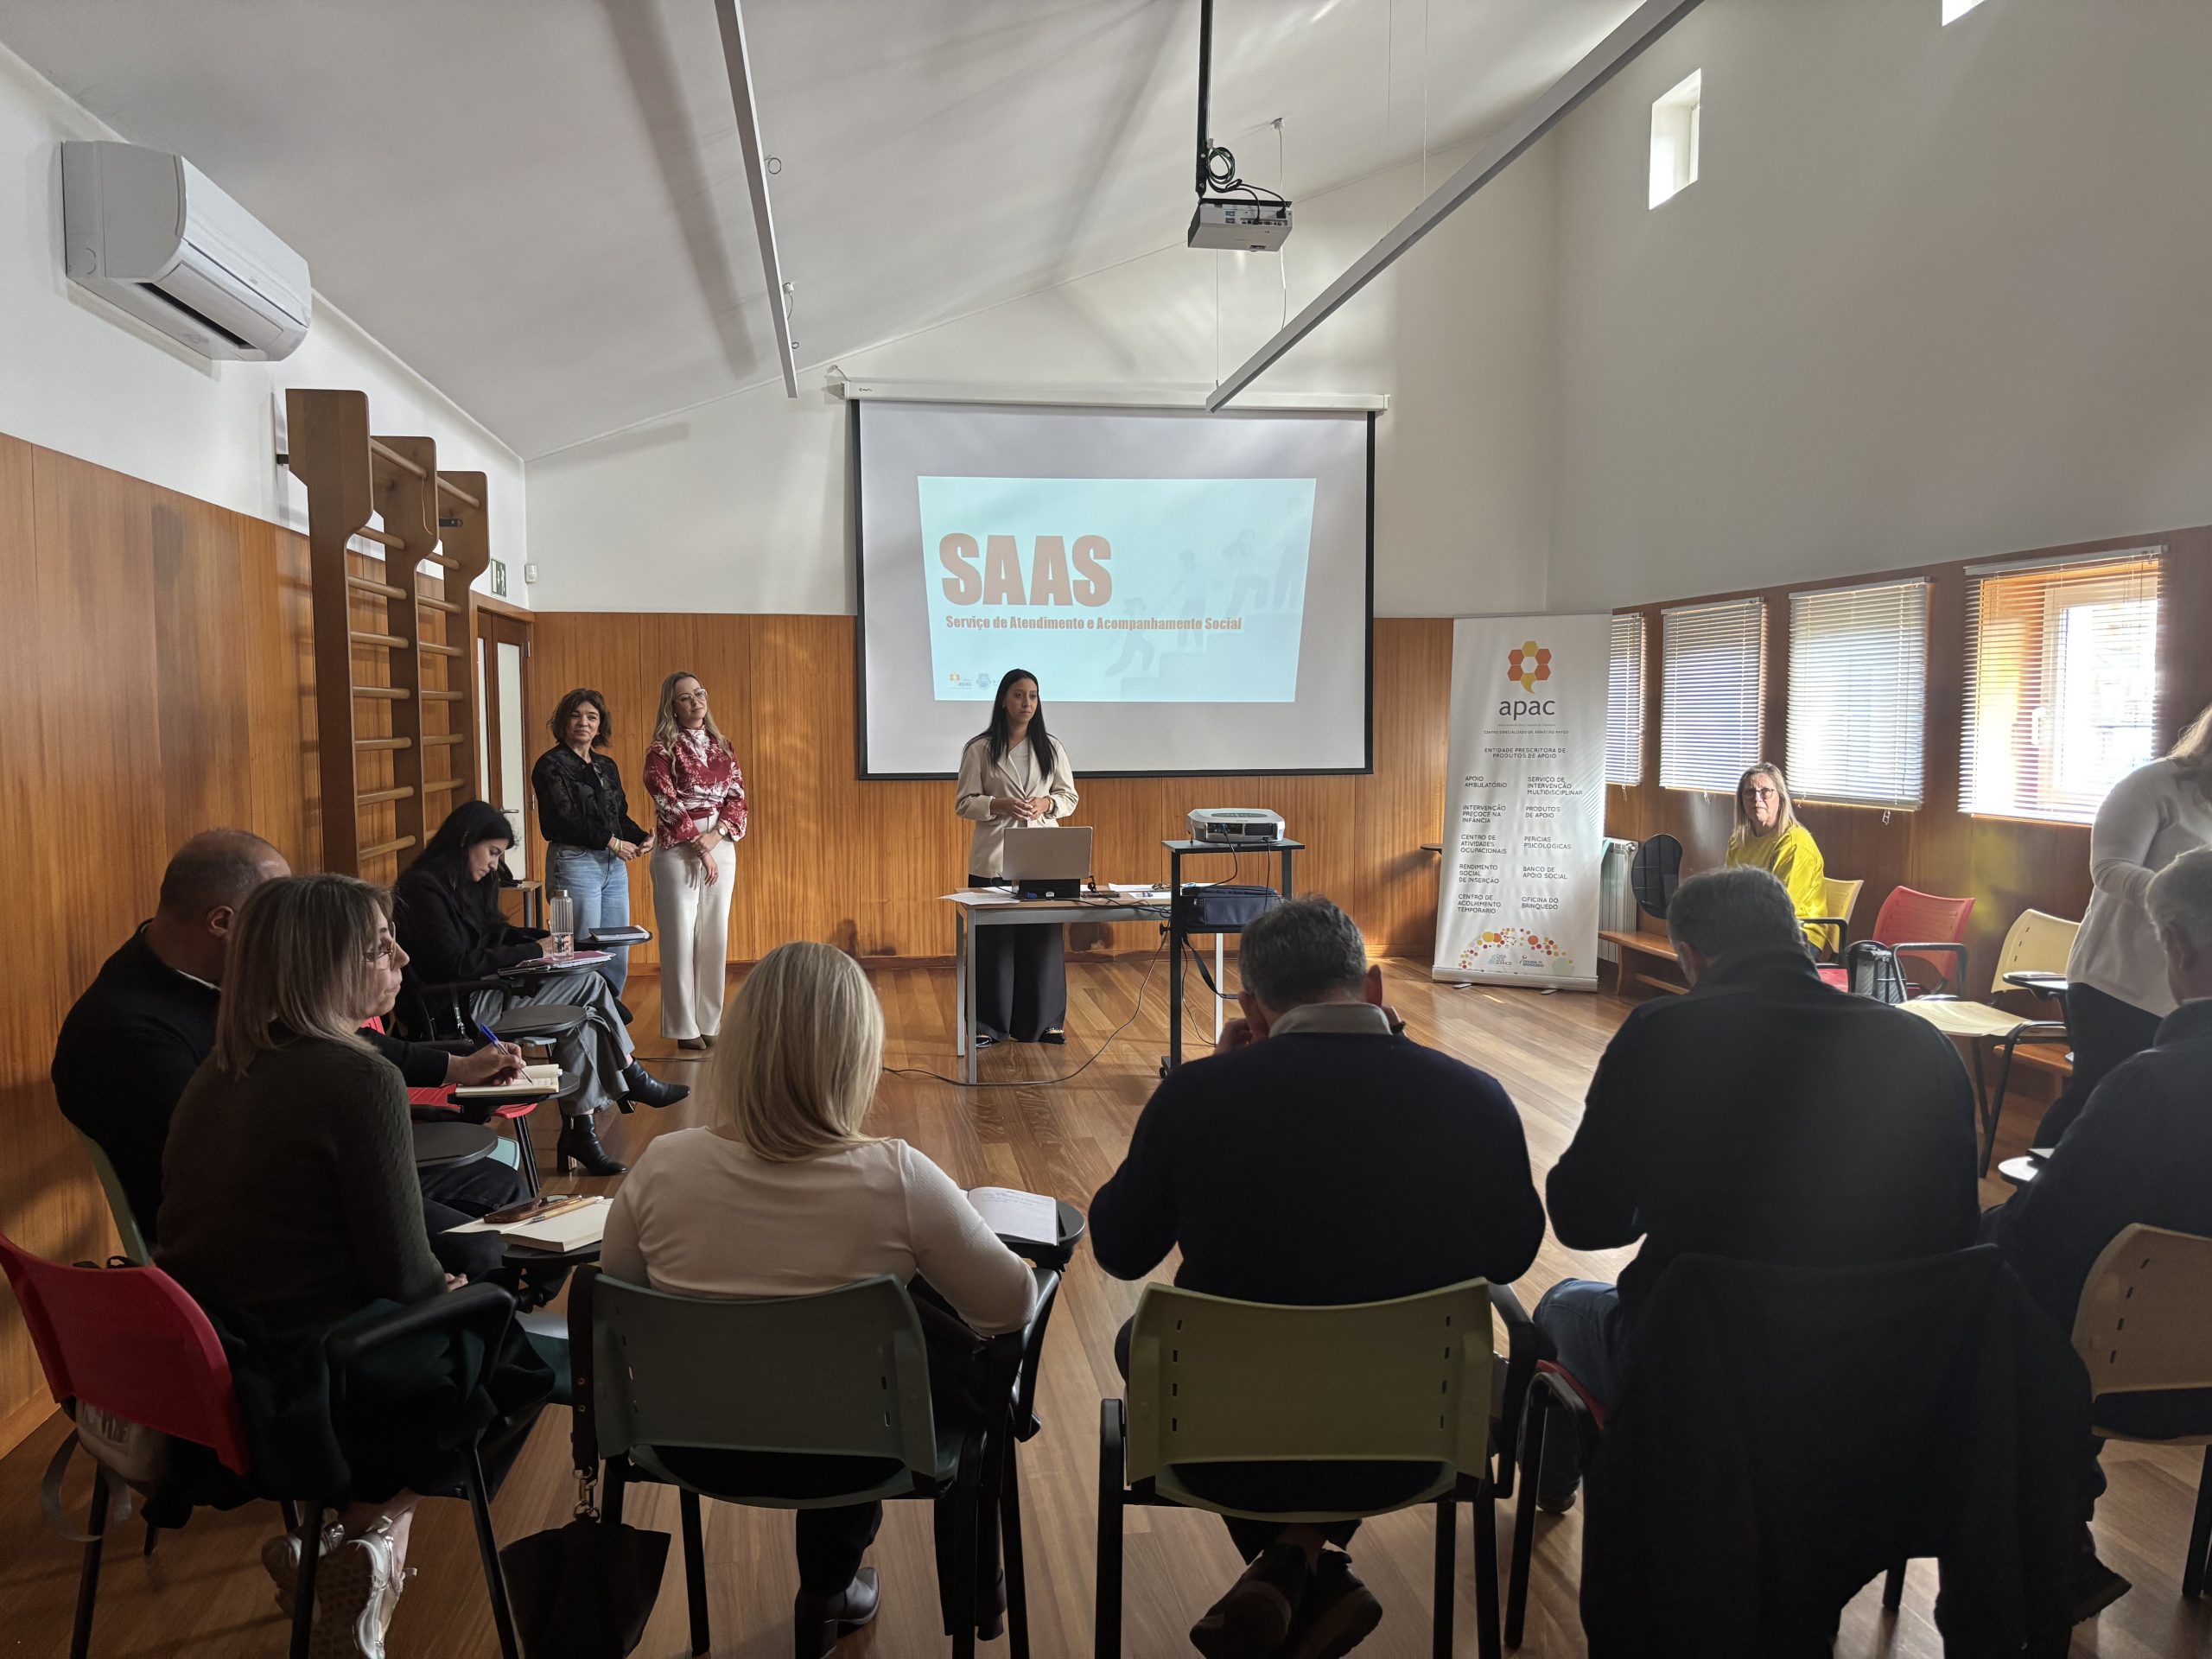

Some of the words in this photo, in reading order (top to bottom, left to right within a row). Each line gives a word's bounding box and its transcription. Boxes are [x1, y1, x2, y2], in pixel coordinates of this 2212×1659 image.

[939, 532, 1113, 607] SAAS
[945, 615, 990, 630] Serviço
[993, 616, 1008, 629] de
[1009, 616, 1085, 629] Atendimento
[1087, 620, 1095, 629] e
[1096, 617, 1203, 631] Acompanhamento
[1205, 617, 1242, 630] Social
[1498, 700, 1555, 721] apac
